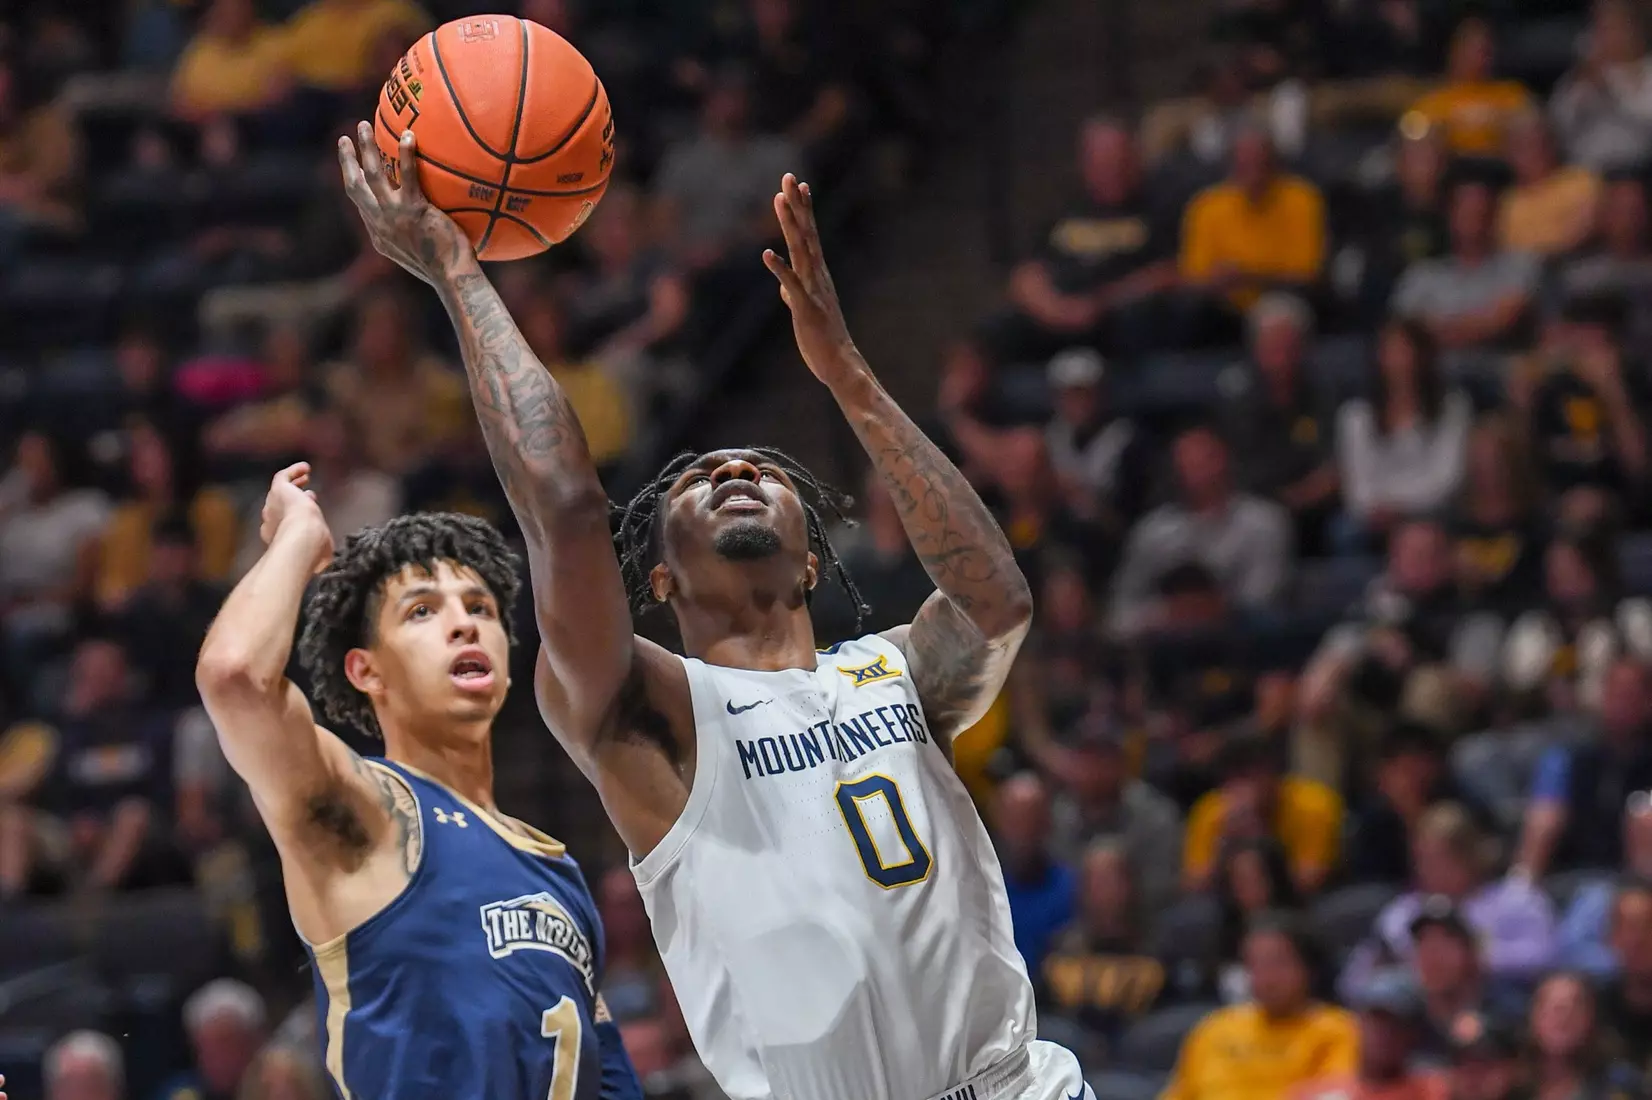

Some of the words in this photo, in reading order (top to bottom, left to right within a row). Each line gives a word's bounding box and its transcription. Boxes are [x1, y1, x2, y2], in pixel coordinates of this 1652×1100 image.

[833, 771, 934, 891] 0
[486, 907, 534, 948] THE
[540, 995, 583, 1100] 1
